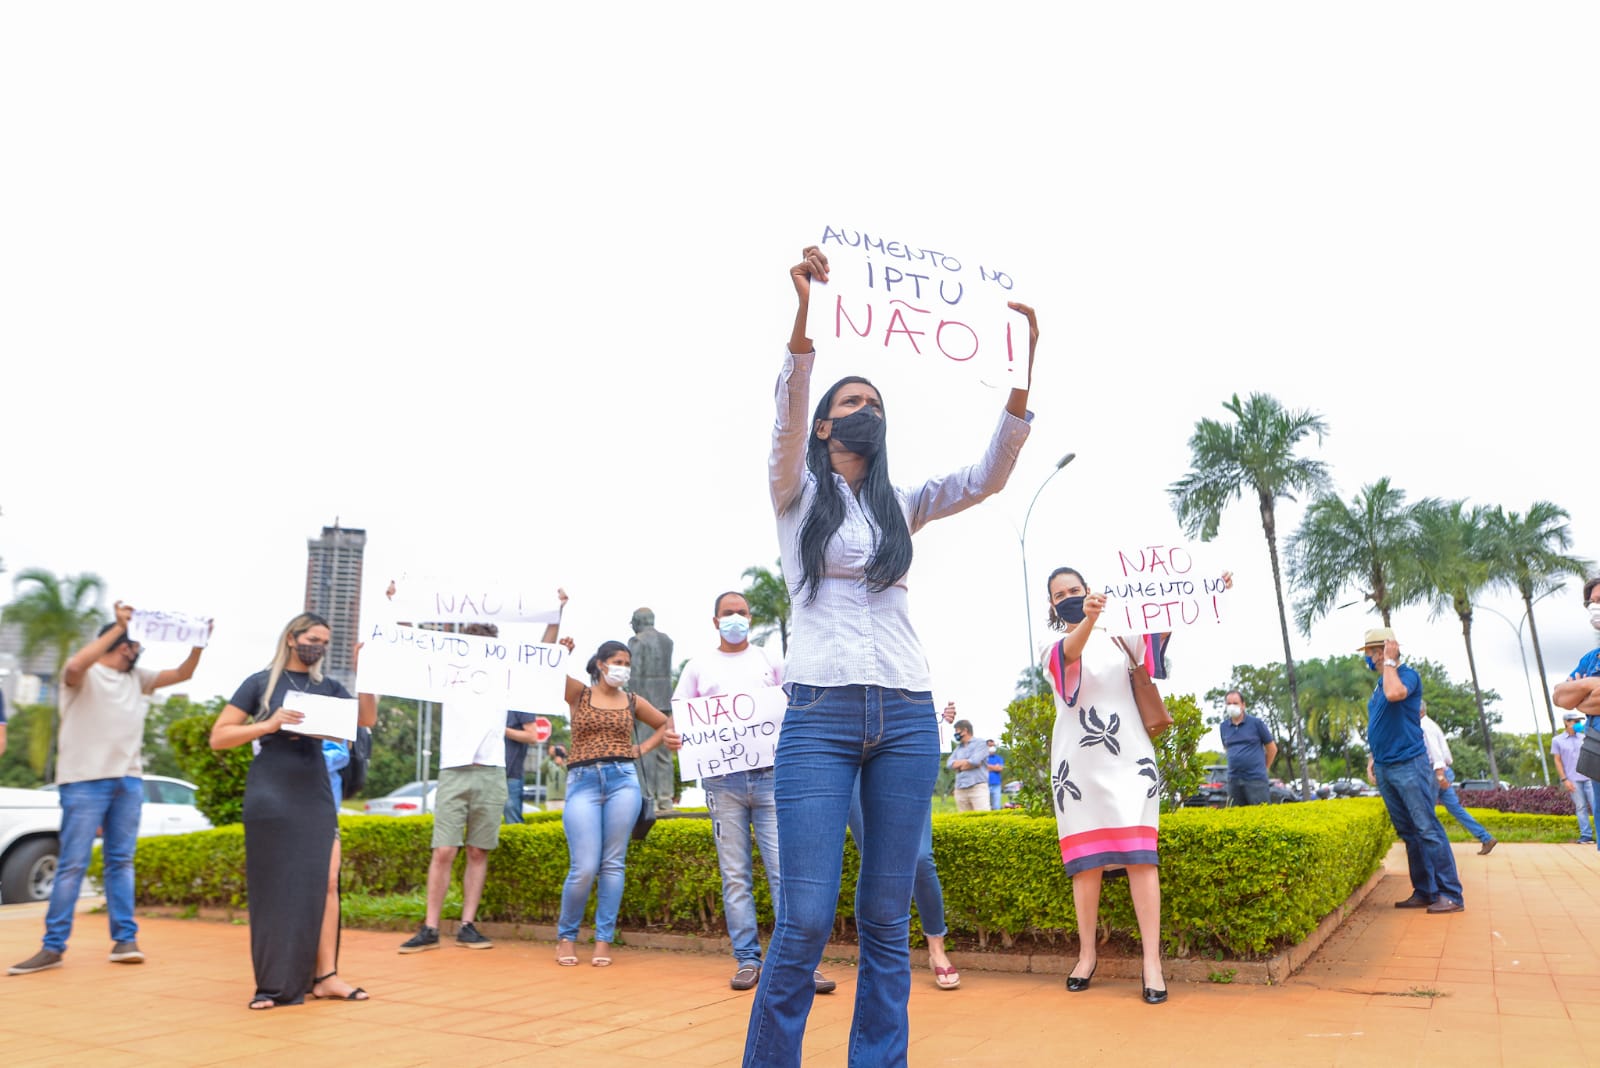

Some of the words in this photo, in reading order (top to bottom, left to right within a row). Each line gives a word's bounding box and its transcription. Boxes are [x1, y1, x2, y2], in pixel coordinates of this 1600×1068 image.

[822, 225, 962, 272] AUMENTO
[979, 265, 1014, 290] NO
[866, 255, 963, 305] IPTU
[835, 294, 979, 361] NÃO
[1118, 545, 1193, 577] NÃO
[1104, 581, 1194, 598] AUMENTO
[1203, 578, 1226, 594] NO
[371, 624, 470, 656] AUMENTO
[485, 643, 507, 660] NO
[517, 643, 563, 668] IPTU
[687, 693, 756, 726] NÃO
[681, 721, 776, 746] AUMENTO
[720, 743, 745, 758] NO
